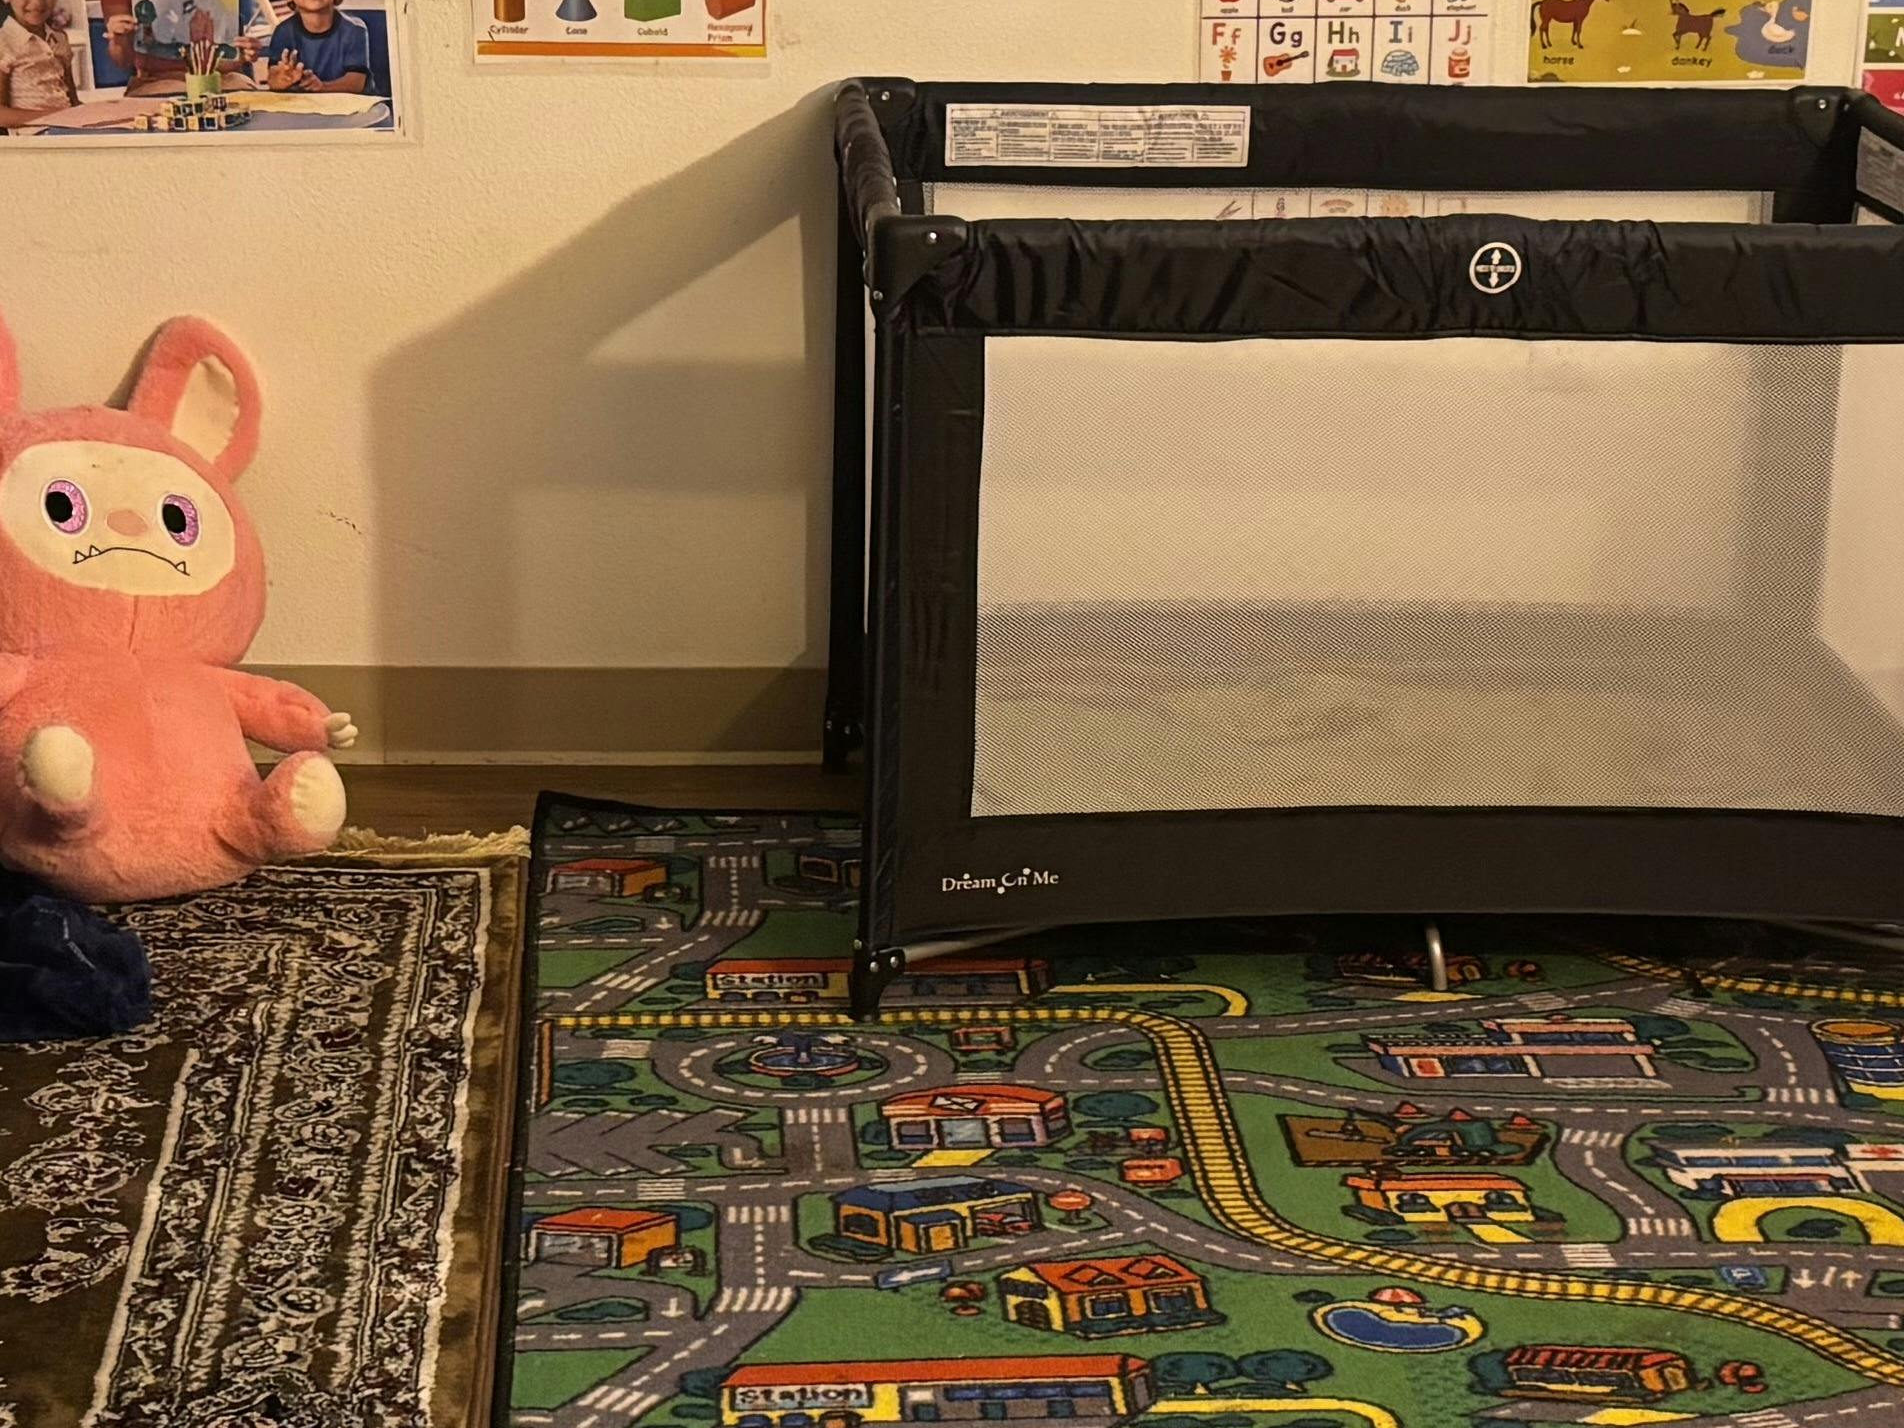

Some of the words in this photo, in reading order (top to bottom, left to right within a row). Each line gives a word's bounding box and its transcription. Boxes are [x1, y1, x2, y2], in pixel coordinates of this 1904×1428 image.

[1543, 55, 1574, 66] horse
[1671, 55, 1713, 67] donkey
[942, 874, 996, 892] Dream
[1033, 871, 1059, 885] Me
